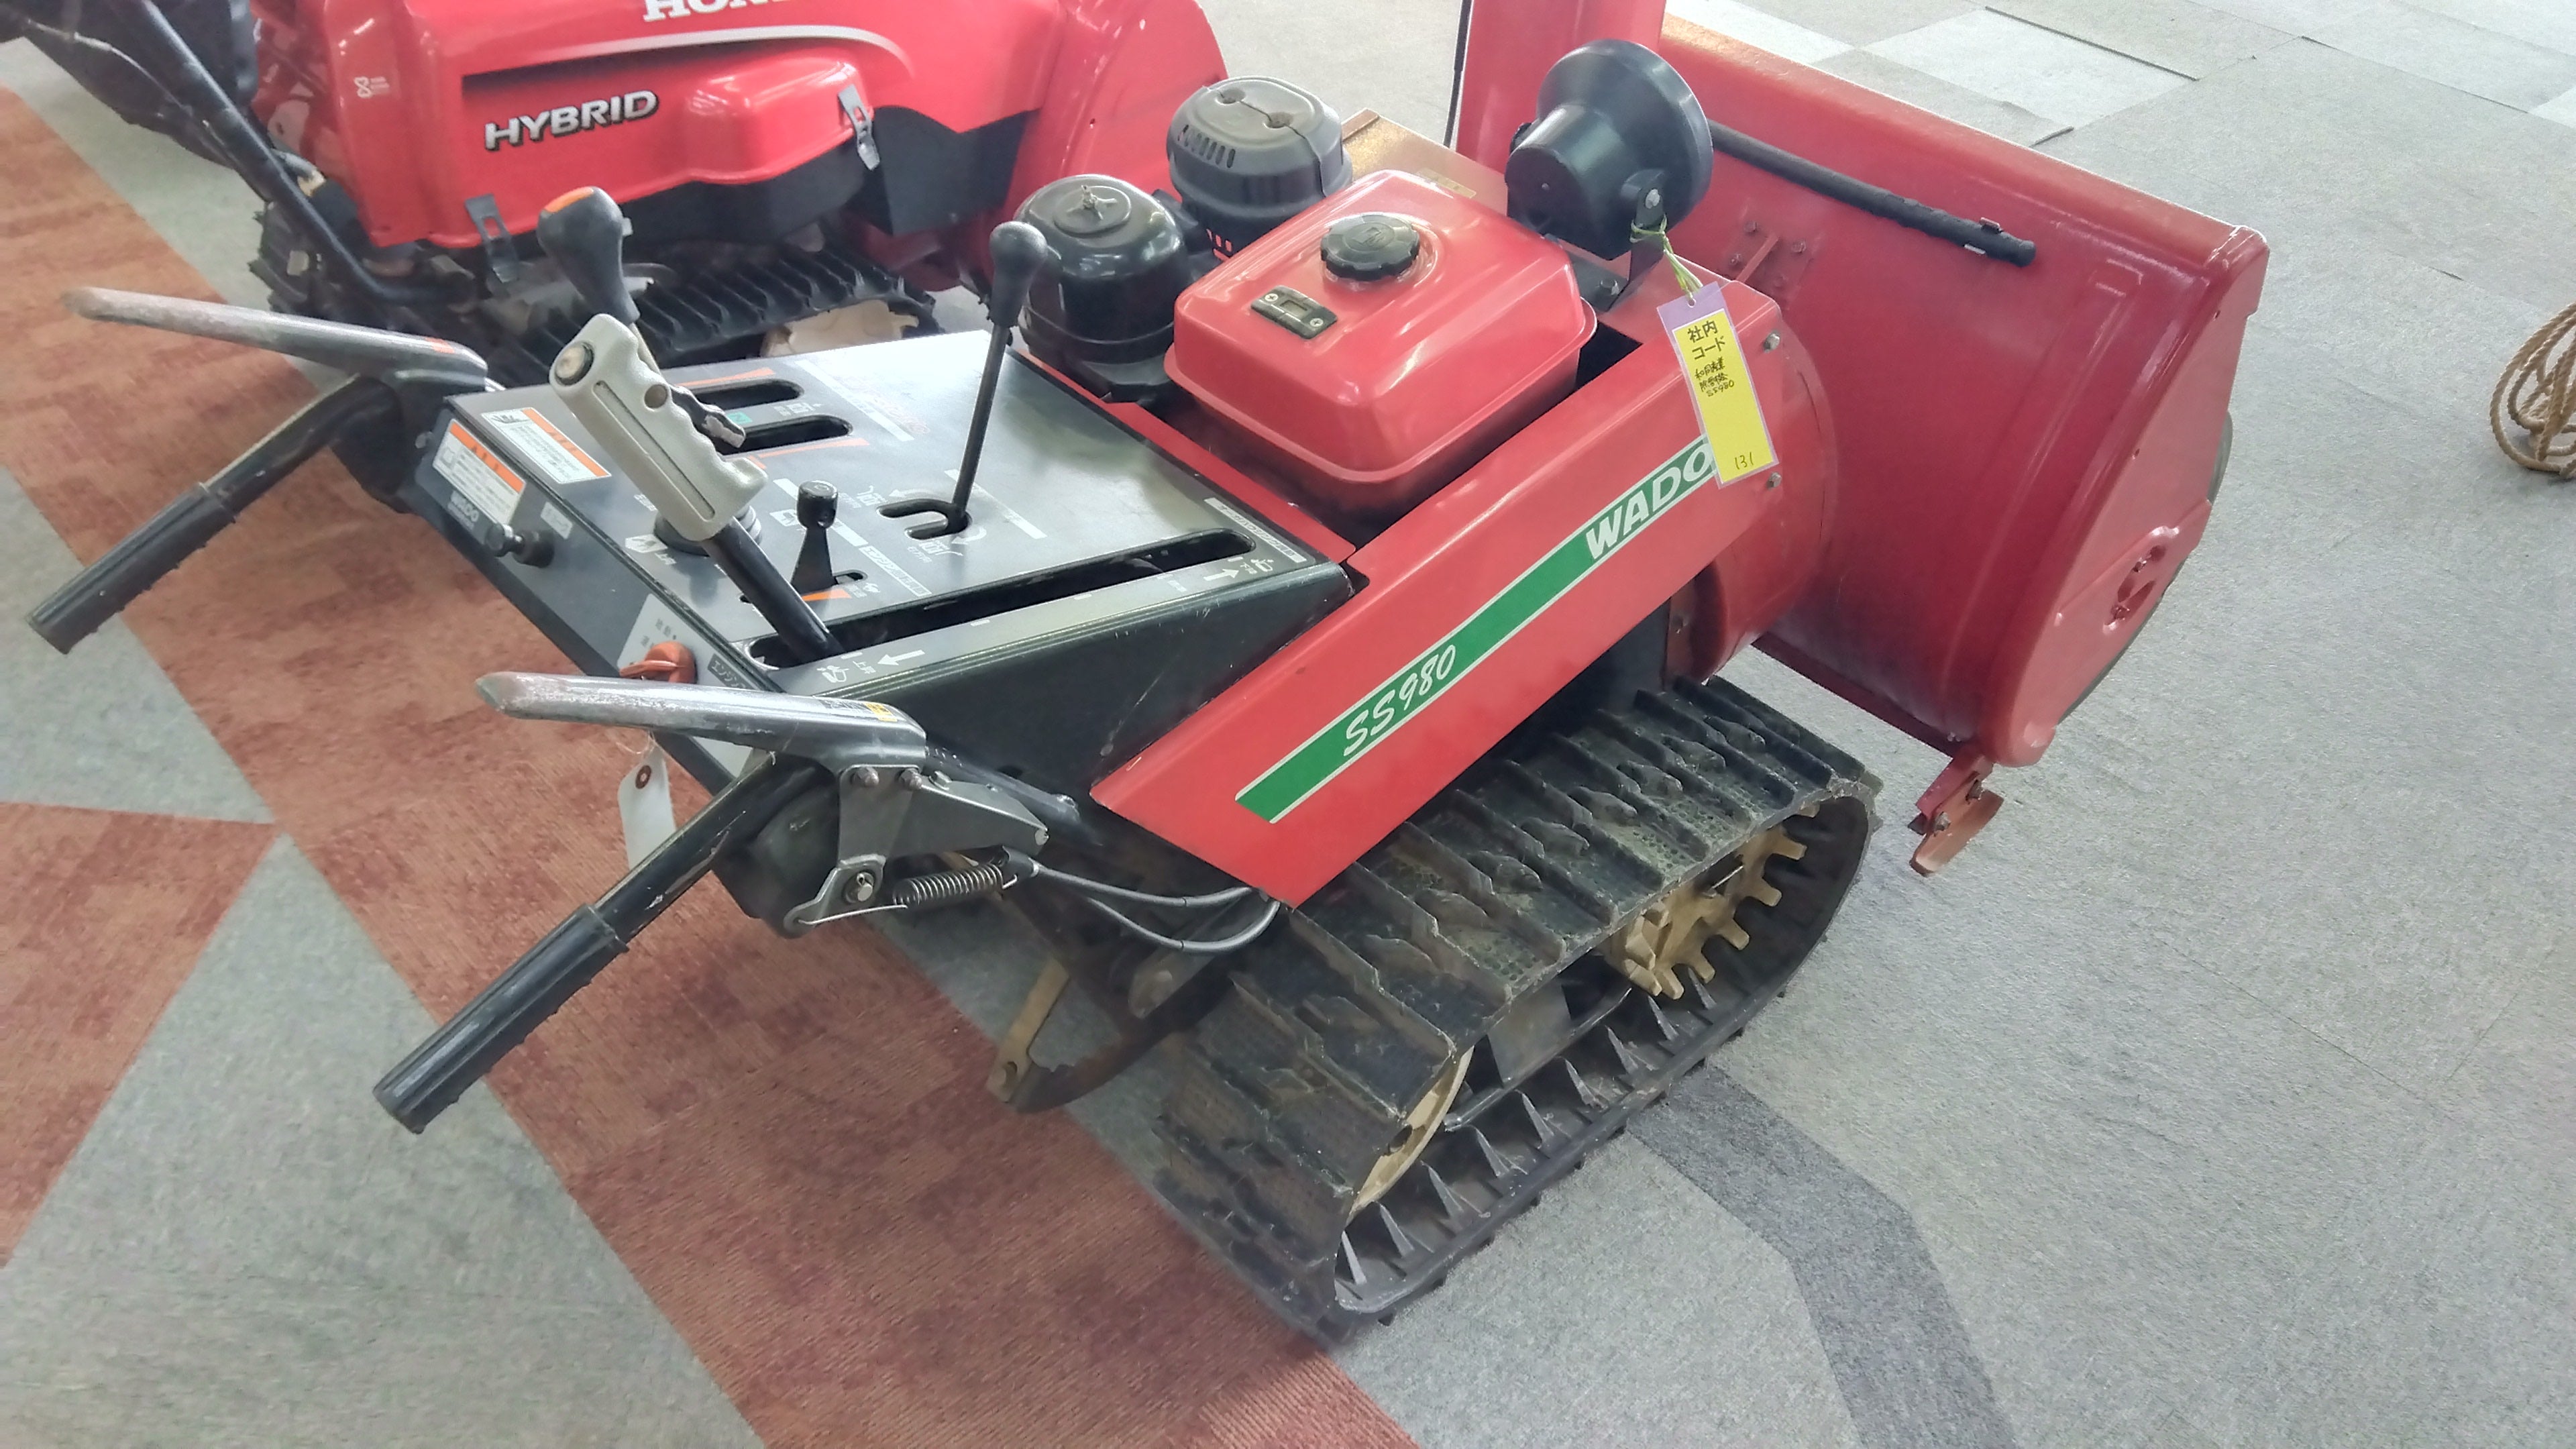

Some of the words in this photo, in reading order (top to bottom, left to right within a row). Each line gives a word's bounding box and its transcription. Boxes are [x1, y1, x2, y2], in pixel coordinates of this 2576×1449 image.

[483, 89, 660, 152] HYBRID
[1687, 320, 1719, 343] 社内
[1692, 335, 1725, 360] コード
[1706, 380, 1735, 397] SS980
[1735, 451, 1754, 470] 131
[1584, 442, 1713, 560] WADO
[1342, 644, 1456, 757] SS980
